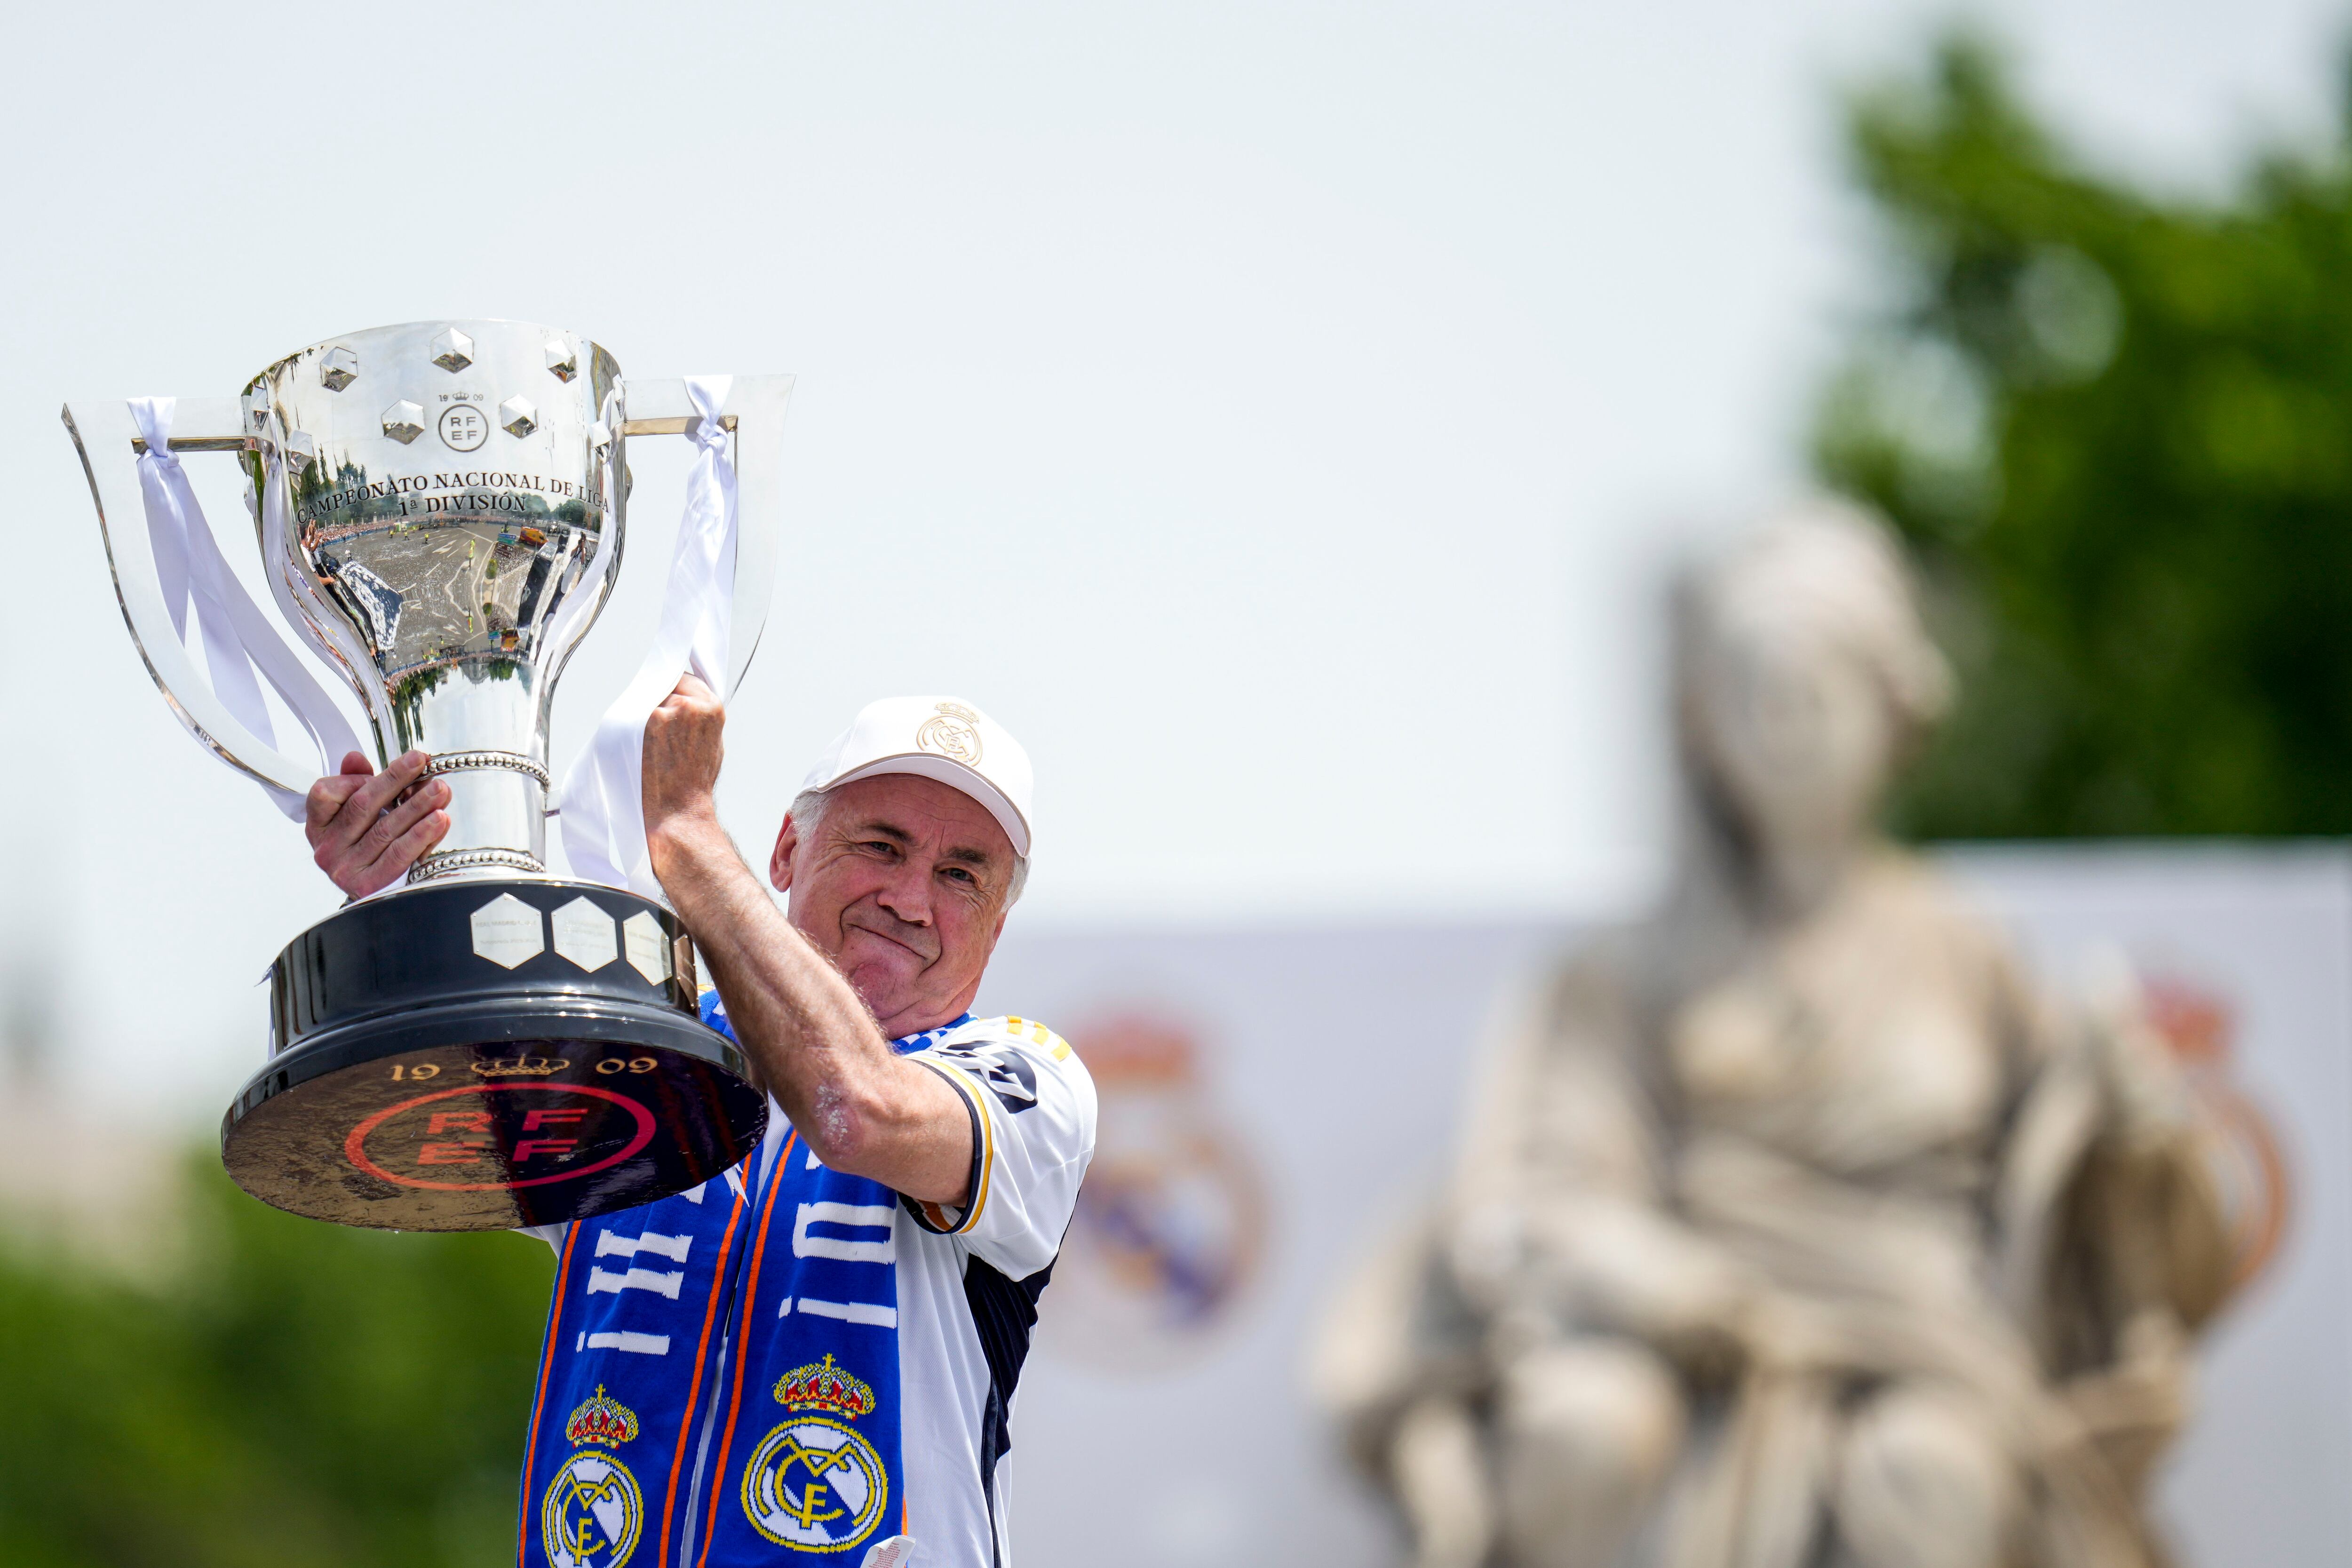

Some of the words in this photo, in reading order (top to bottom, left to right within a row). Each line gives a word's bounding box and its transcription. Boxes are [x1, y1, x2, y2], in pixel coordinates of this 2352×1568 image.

[297, 476, 428, 524] CAMPEONATO
[433, 472, 545, 491] NACIONAL
[550, 478, 573, 497] DE
[578, 486, 609, 513] LIGA
[398, 498, 418, 517] 1ª
[425, 492, 526, 513] DIVISIÓN
[390, 1064, 440, 1081] 19
[596, 1057, 658, 1074] 09
